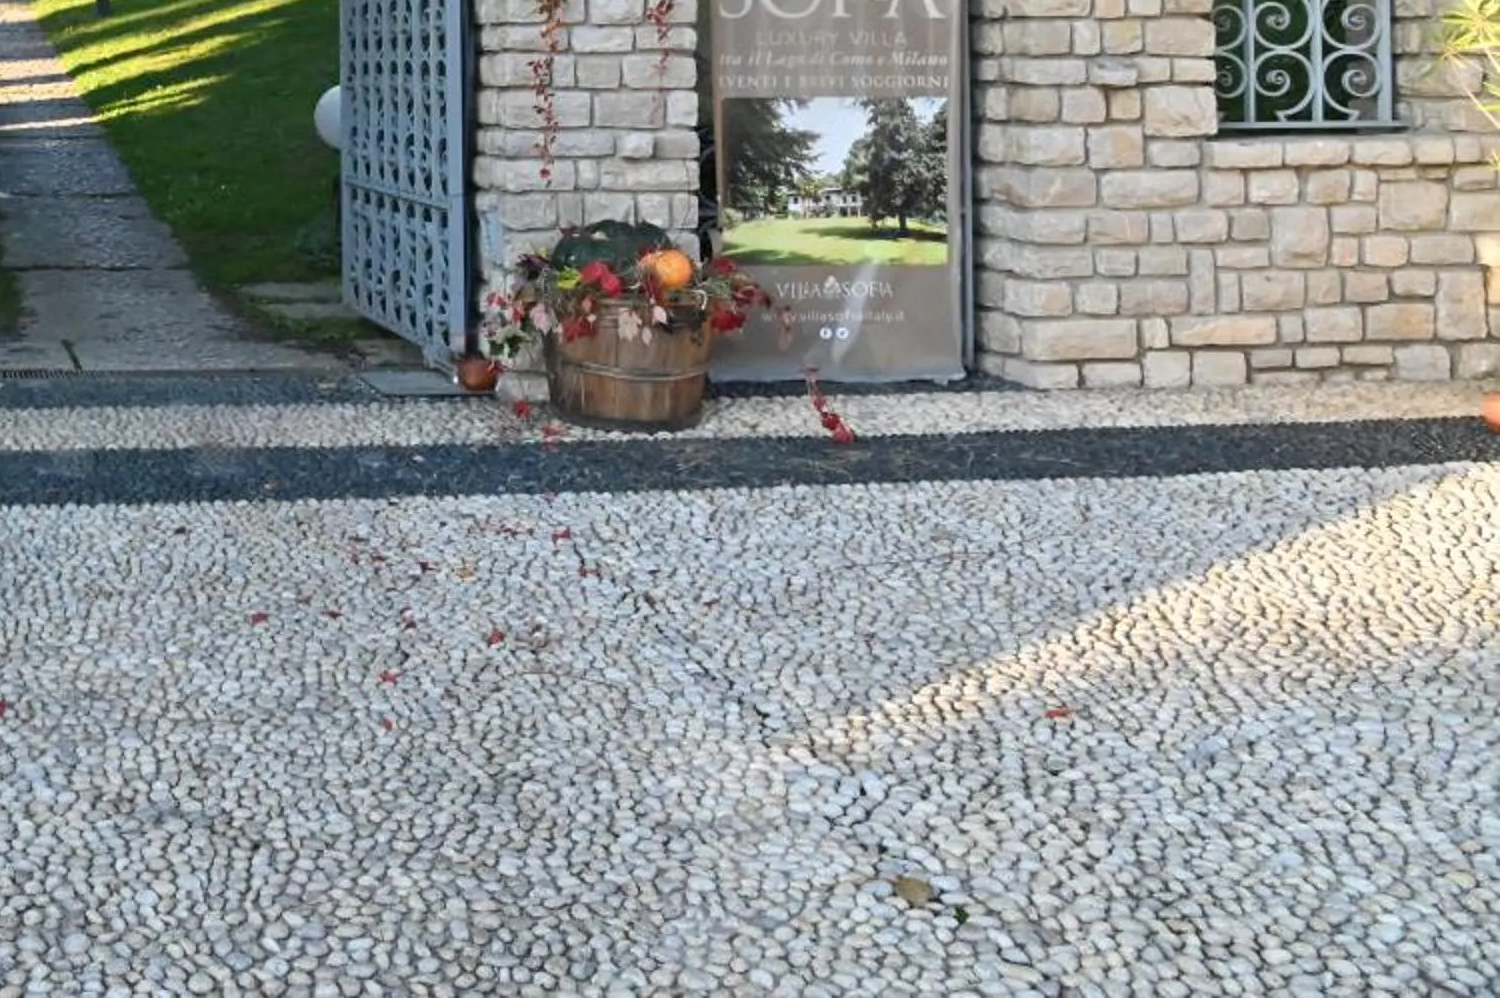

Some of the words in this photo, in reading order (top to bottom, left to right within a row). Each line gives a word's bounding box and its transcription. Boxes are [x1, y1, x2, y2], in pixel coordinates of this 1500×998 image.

[848, 30, 907, 47] VILLA
[891, 49, 948, 67] Milano
[718, 74, 777, 89] EVENTI
[851, 74, 949, 90] SOGGIORNI
[775, 281, 822, 299] VILLA
[840, 280, 894, 299] SOFIA
